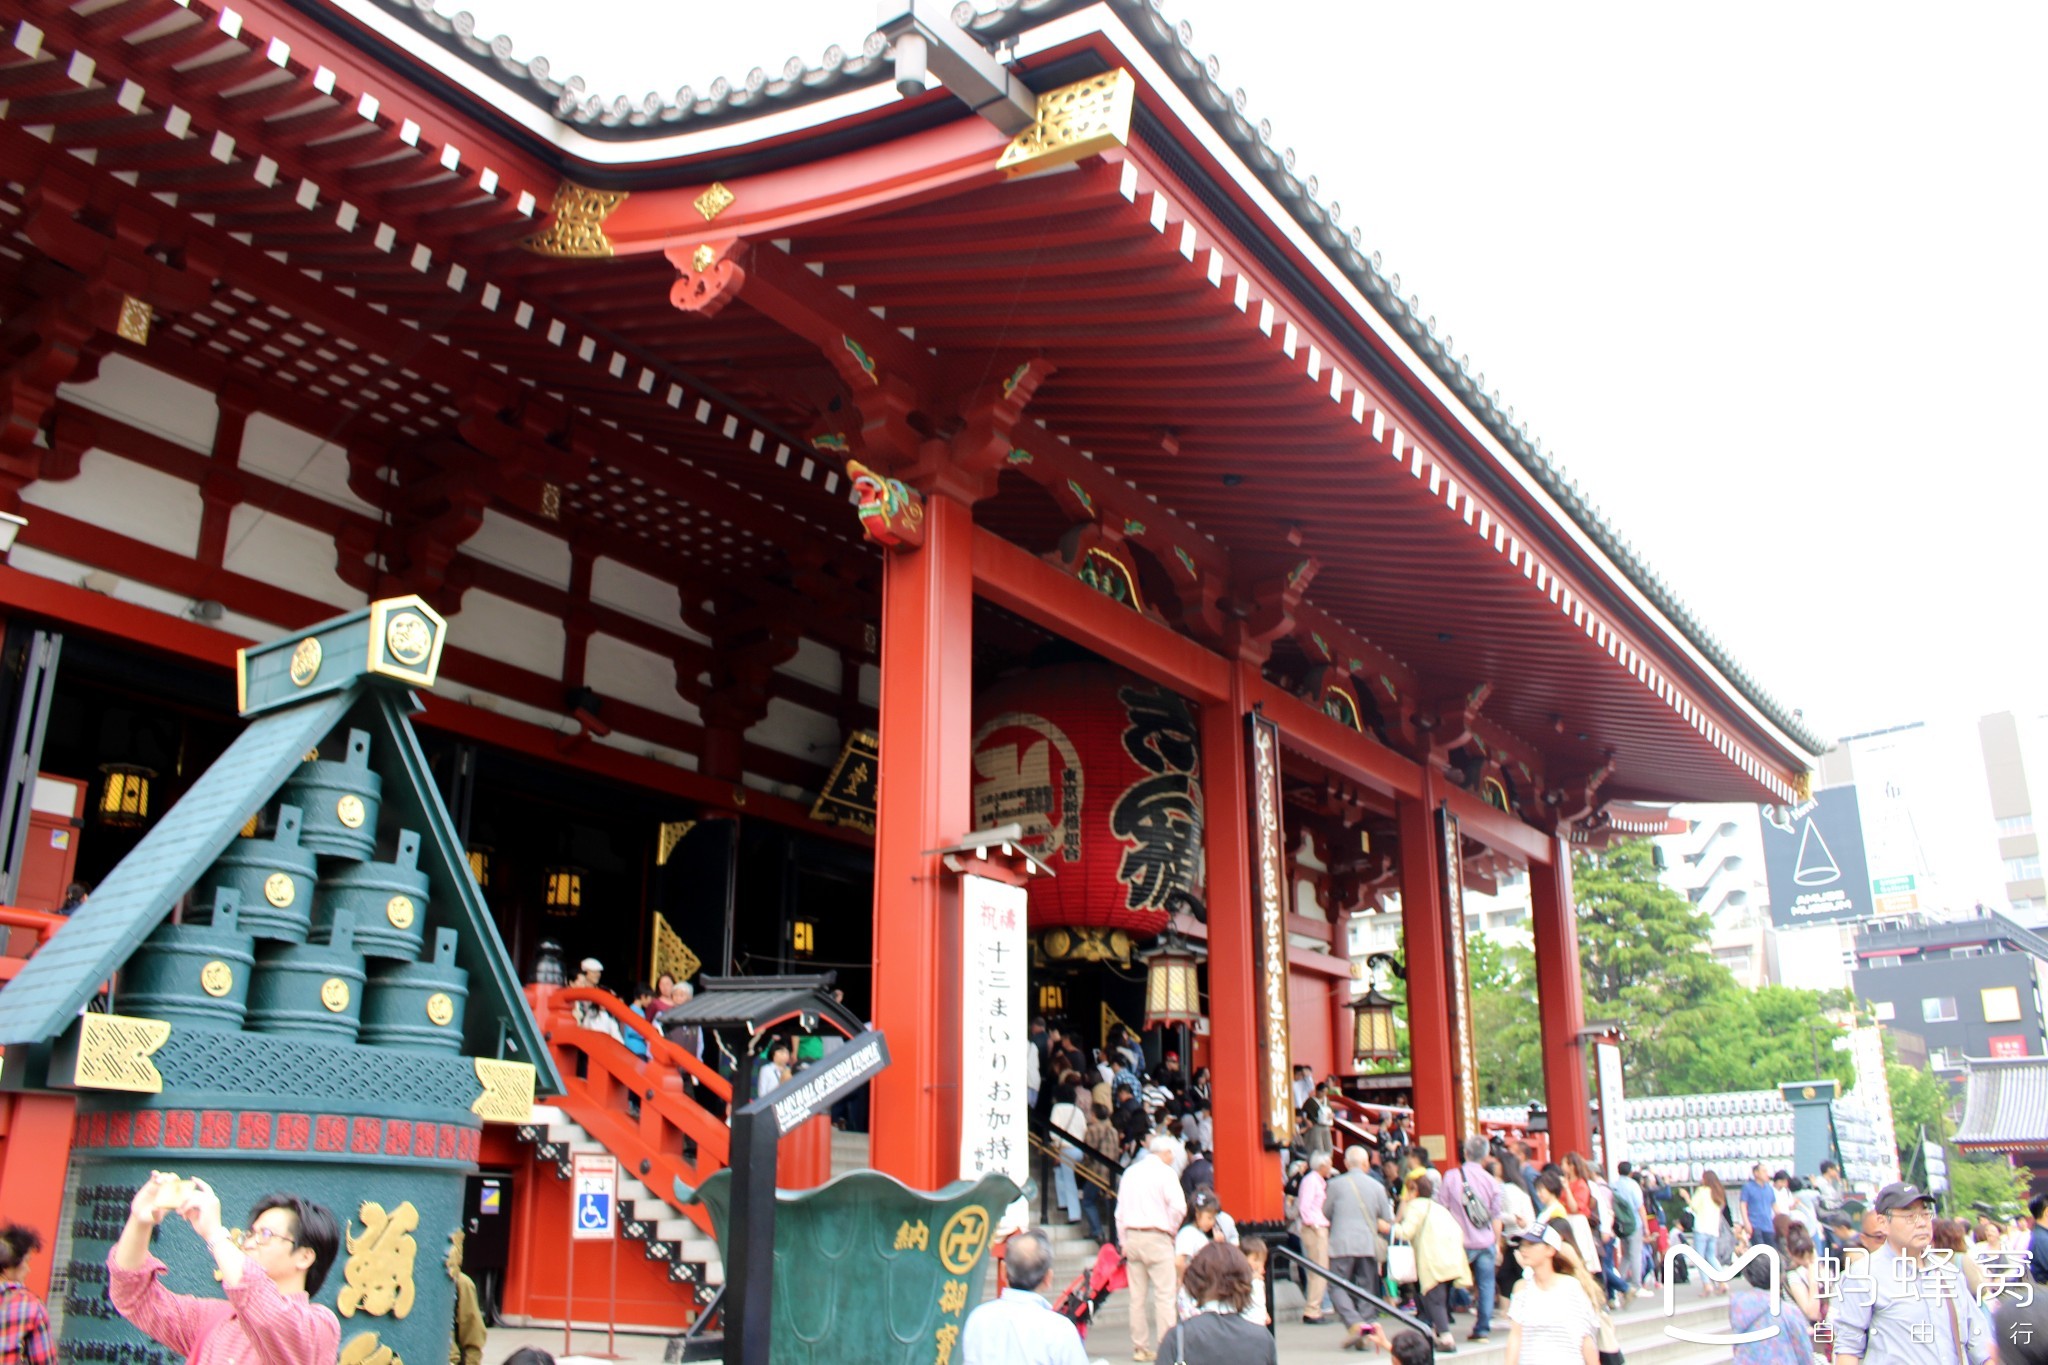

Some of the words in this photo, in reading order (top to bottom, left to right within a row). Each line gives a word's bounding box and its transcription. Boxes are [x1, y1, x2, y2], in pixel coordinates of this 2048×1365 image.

[1790, 899, 1853, 916] MUSEUM
[986, 940, 1012, 1176] 十三まいりお加持
